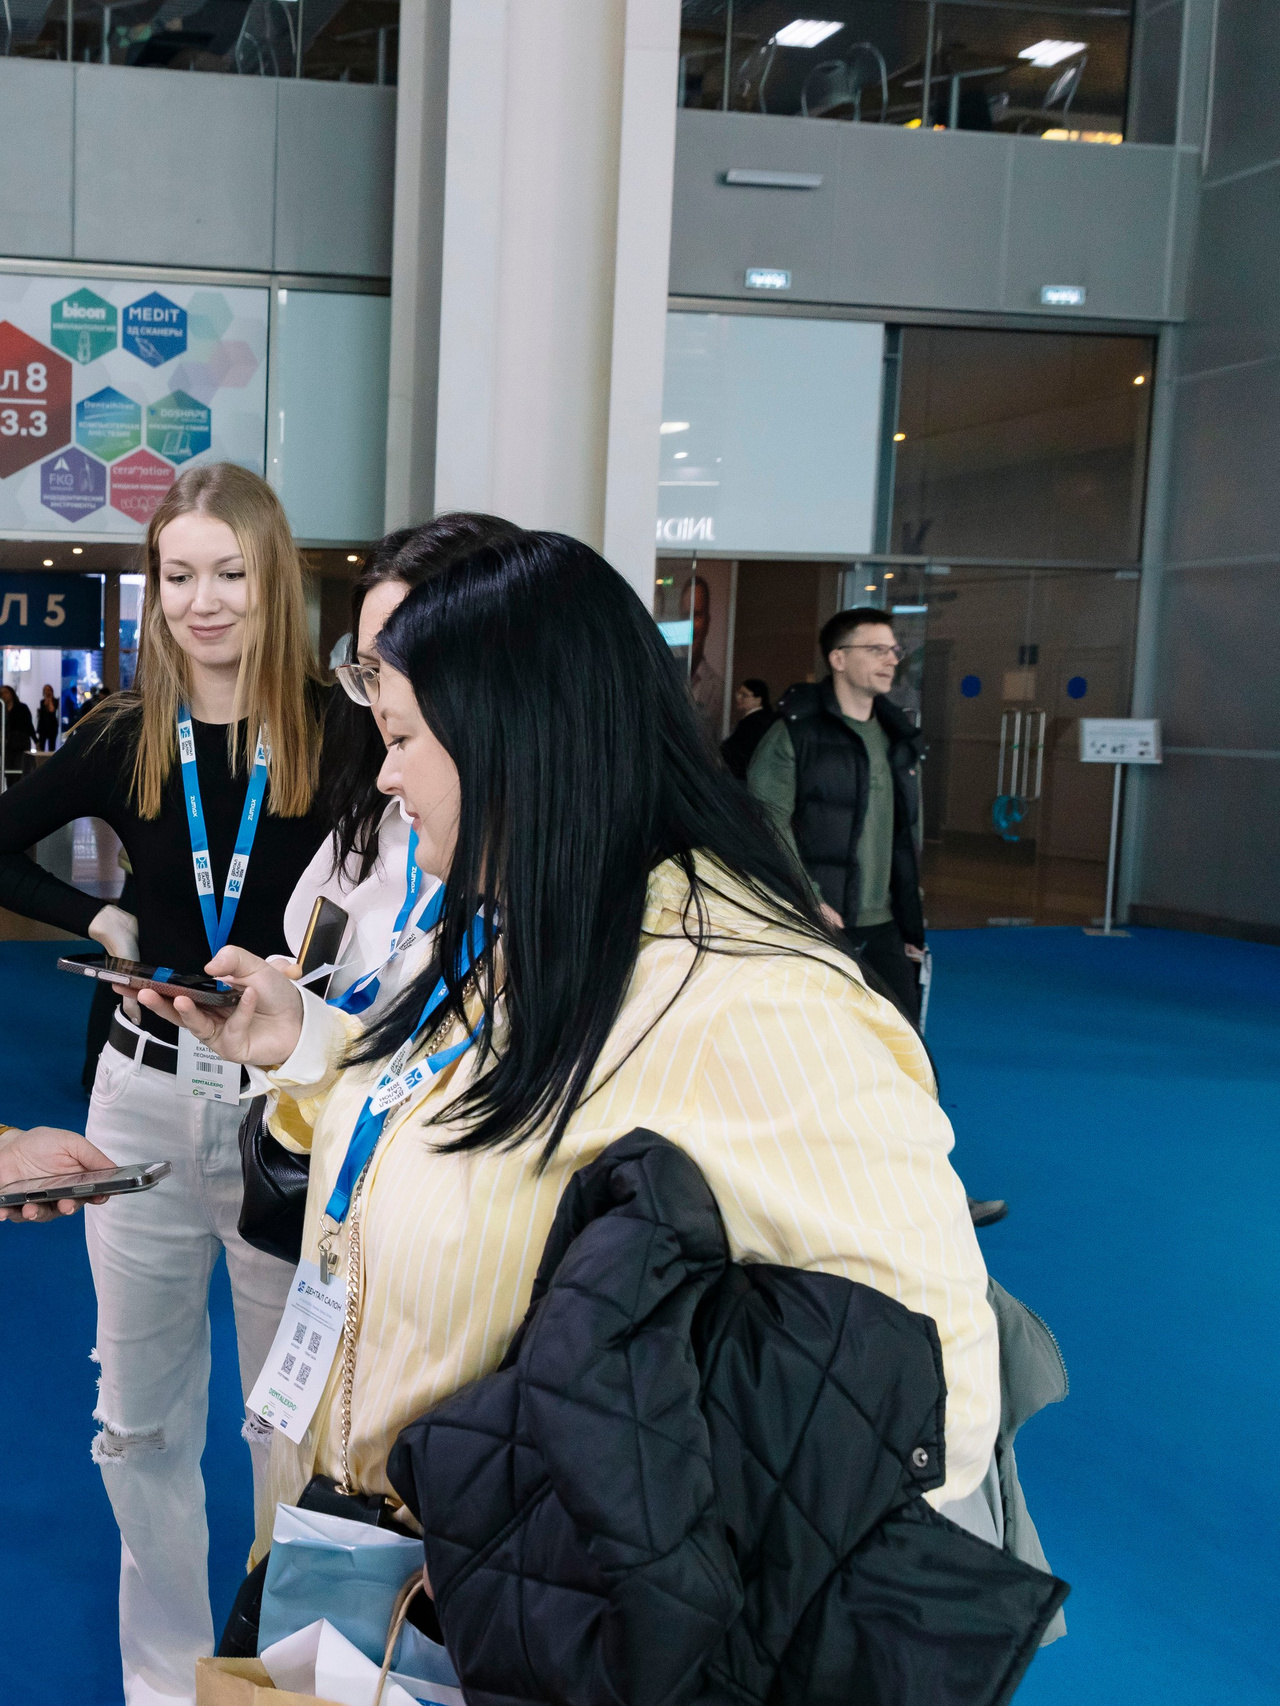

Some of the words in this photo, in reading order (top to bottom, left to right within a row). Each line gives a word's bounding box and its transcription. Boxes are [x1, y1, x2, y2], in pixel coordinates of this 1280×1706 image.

[62, 301, 106, 321] bicon
[128, 307, 180, 323] MEDIT
[26, 362, 48, 393] 8
[44, 593, 67, 628] 5
[191, 1078, 224, 1089] DENTALEXPO
[379, 1086, 403, 1102] САЛОН
[379, 1090, 404, 1108] ДЕНТАЛ
[305, 1285, 324, 1302] ДЕНТАЛ
[323, 1296, 342, 1312] САЛОН
[268, 1387, 297, 1412] DENTALEXPO
